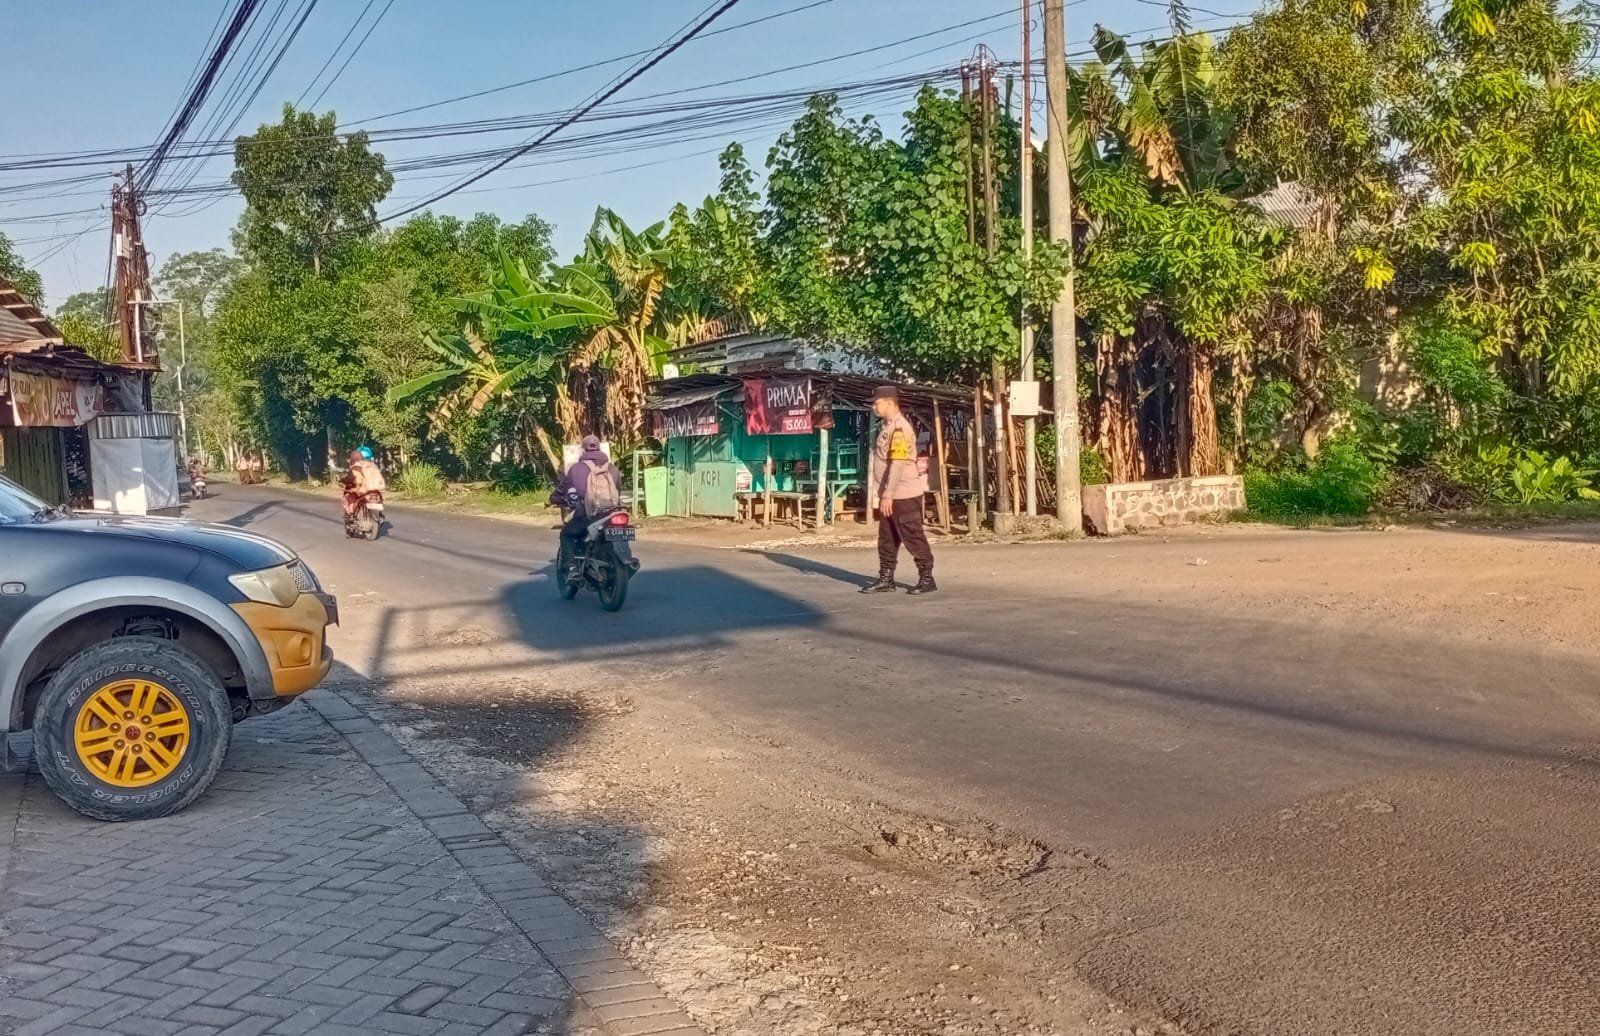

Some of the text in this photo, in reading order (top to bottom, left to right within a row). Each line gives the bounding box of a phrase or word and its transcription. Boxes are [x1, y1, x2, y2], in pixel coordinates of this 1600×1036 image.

[766, 384, 807, 409] PRIMA
[700, 470, 721, 487] KOPI
[67, 663, 206, 724] BRIDGESTONE
[56, 751, 193, 804] DUELER A/T
